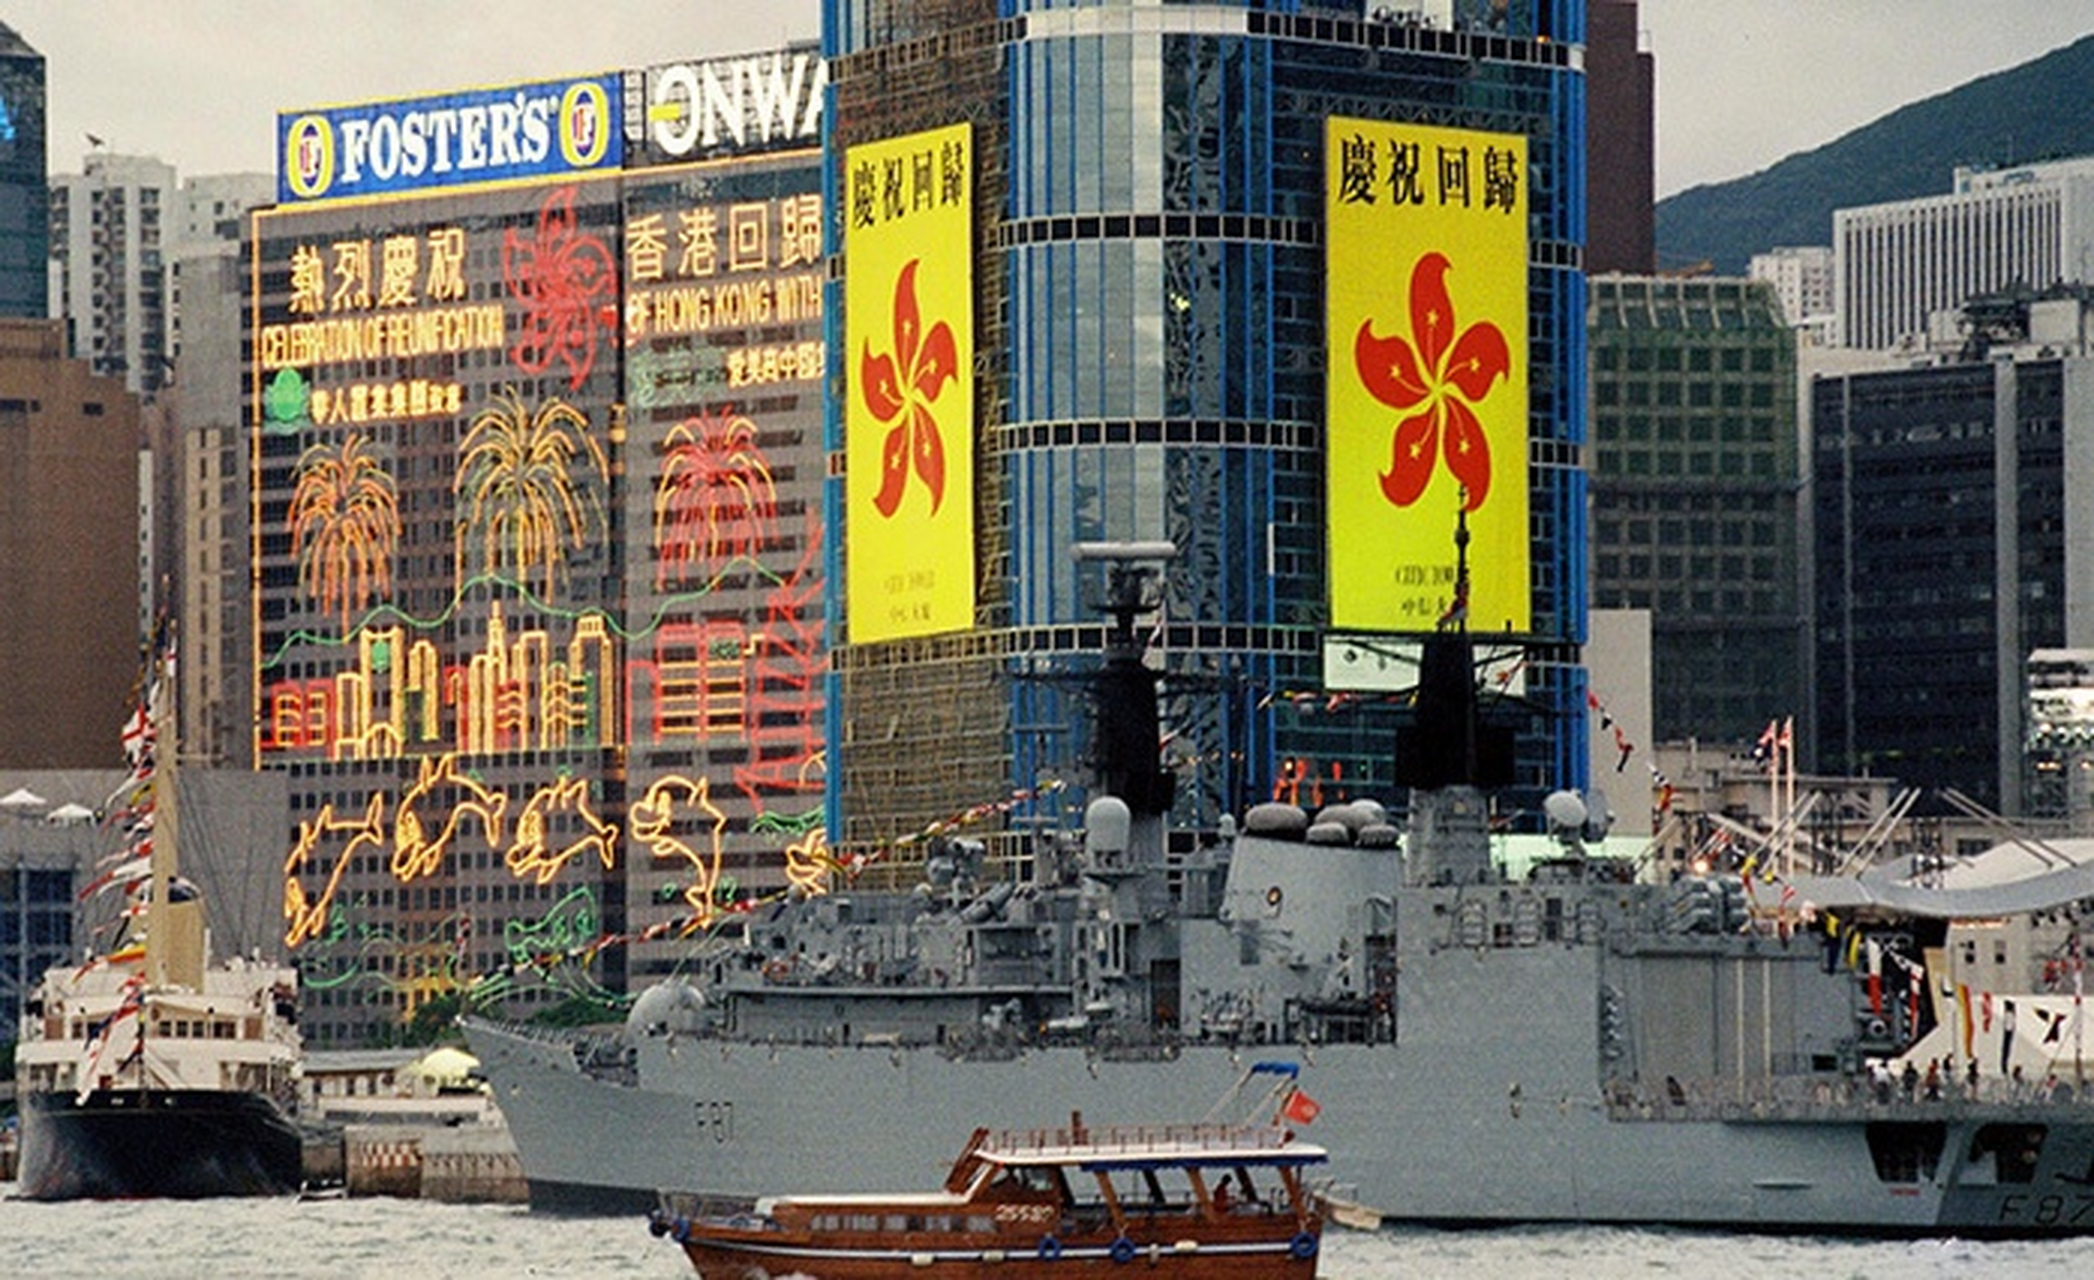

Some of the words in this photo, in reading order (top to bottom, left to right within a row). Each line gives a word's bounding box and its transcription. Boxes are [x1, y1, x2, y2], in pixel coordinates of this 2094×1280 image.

[340, 92, 552, 183] FOSTER'S
[1338, 132, 1518, 214] 慶祝回歸
[853, 141, 964, 229] 慶祝回歸
[289, 228, 466, 313] 熱烈慶祝
[626, 194, 822, 281] 香港回歸
[627, 290, 651, 334] OF
[655, 287, 710, 332] HONG
[714, 278, 771, 326] KONG
[694, 1101, 735, 1144] F87
